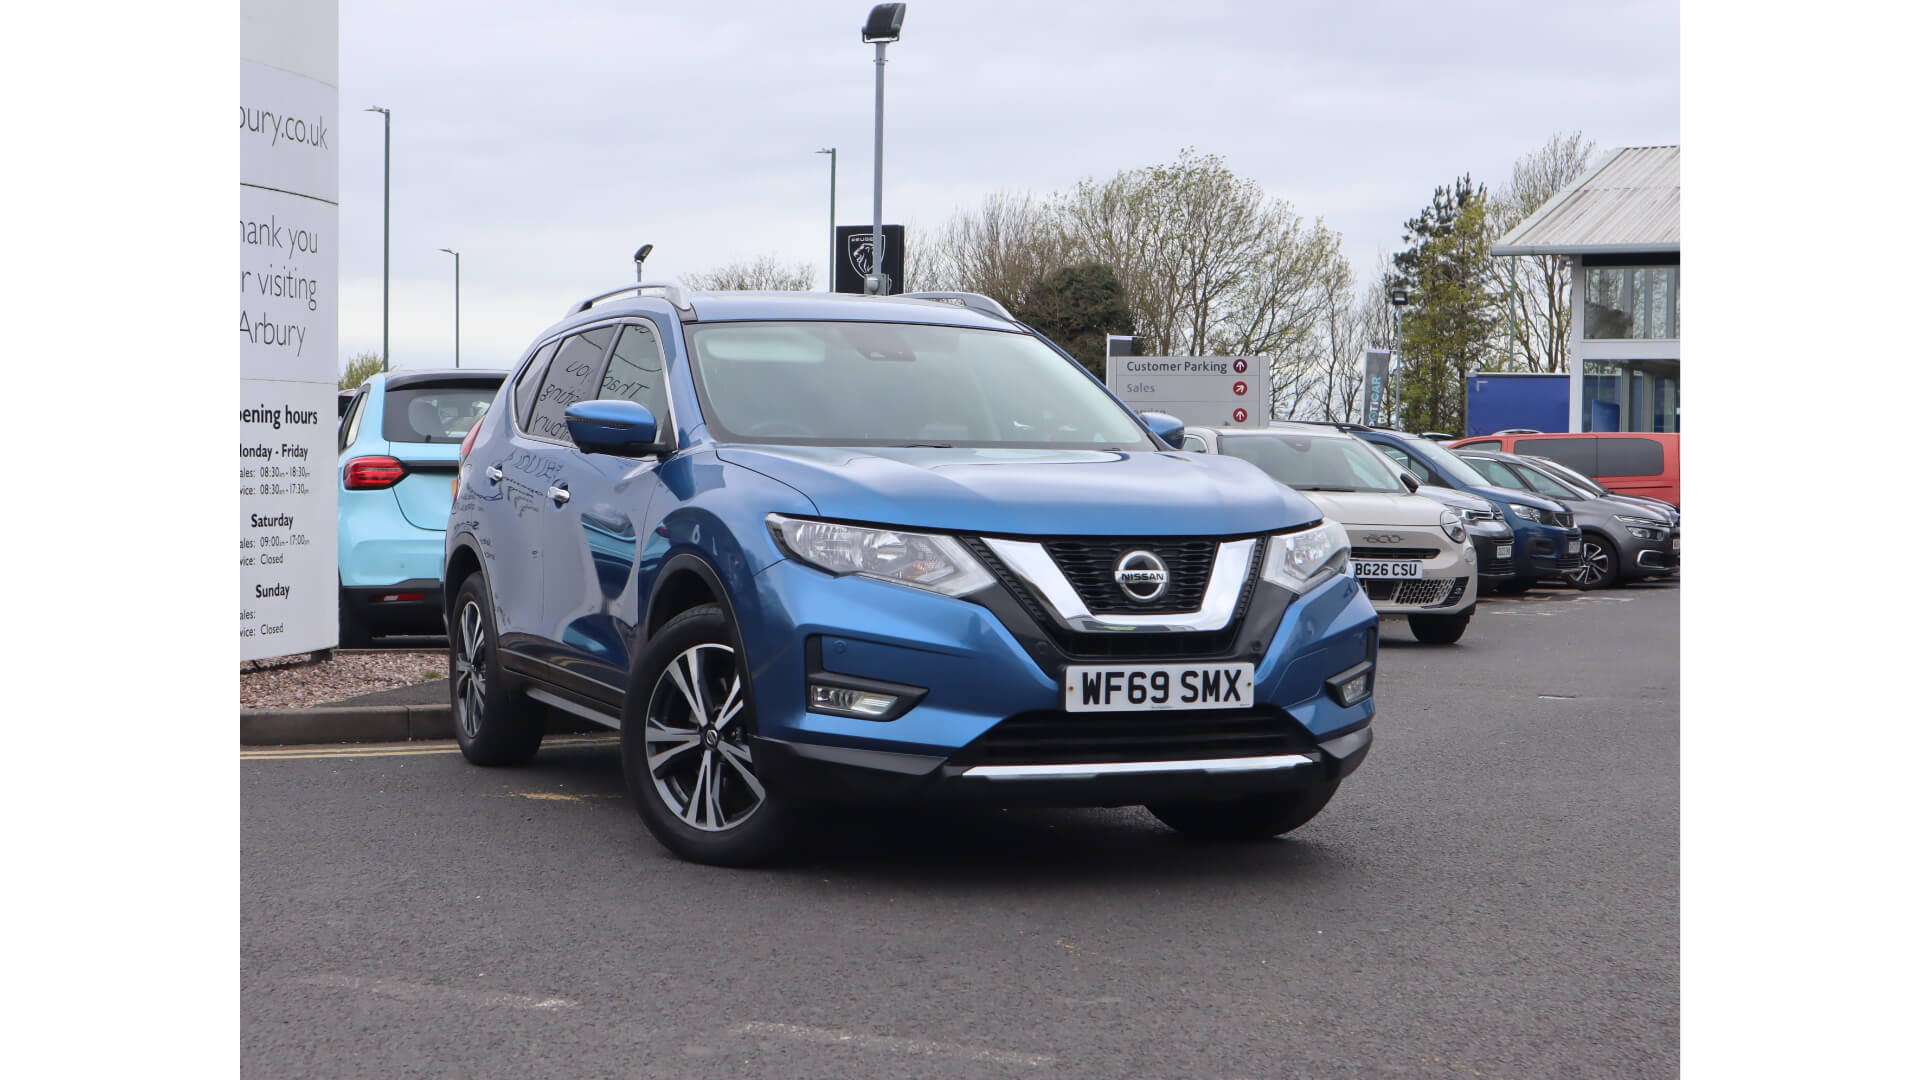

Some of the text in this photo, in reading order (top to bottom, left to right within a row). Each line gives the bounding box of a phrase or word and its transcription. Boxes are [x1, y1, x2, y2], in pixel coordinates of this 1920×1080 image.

[288, 227, 318, 260] you
[257, 264, 317, 311] visiting
[1126, 361, 1228, 375] Customer Parking
[1126, 383, 1155, 393] Sales
[240, 403, 318, 430] ening hours
[240, 443, 273, 462] onday
[281, 443, 309, 461] Friday
[251, 512, 294, 530] Saturday
[260, 552, 284, 565] Closed
[1121, 573, 1164, 581] NISSAN
[1355, 562, 1417, 576] BG26 CSU
[255, 582, 290, 600] Sunday
[260, 622, 284, 635] Closed
[1082, 669, 1242, 705] WF69 SMX
